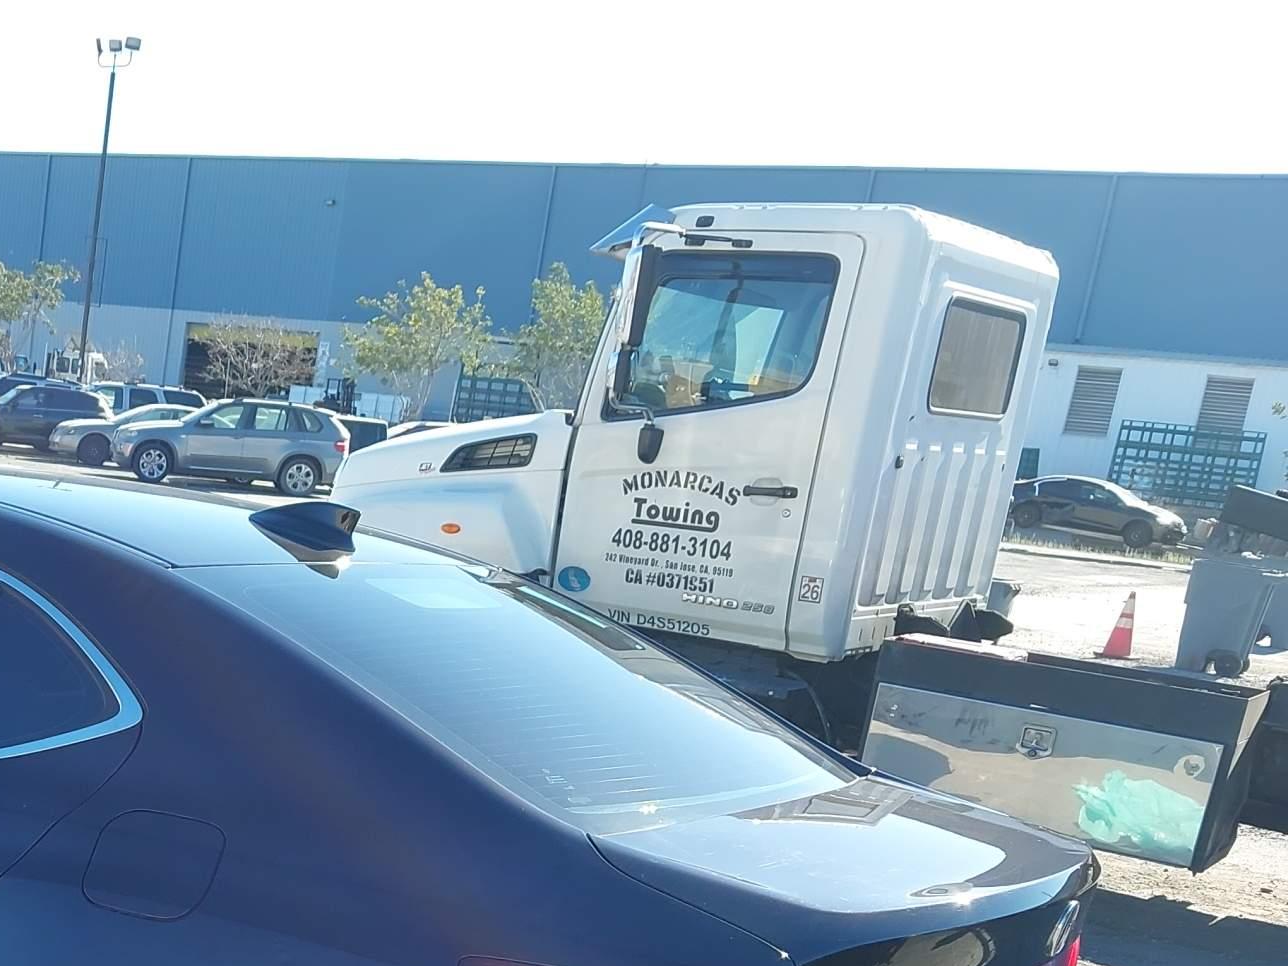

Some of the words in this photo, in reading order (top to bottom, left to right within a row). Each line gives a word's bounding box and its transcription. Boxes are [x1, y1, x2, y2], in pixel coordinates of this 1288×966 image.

[622, 470, 742, 506] MONARCAS
[631, 497, 720, 533] Towing
[612, 528, 732, 561] 408-881-3104
[605, 552, 617, 562] 242
[619, 554, 649, 566] Vineyard
[664, 559, 678, 570] San
[624, 567, 643, 585] CA
[681, 592, 739, 610] HINO
[801, 583, 820, 601] 26
[607, 608, 630, 624] VIN
[636, 613, 710, 636] D4S51205
